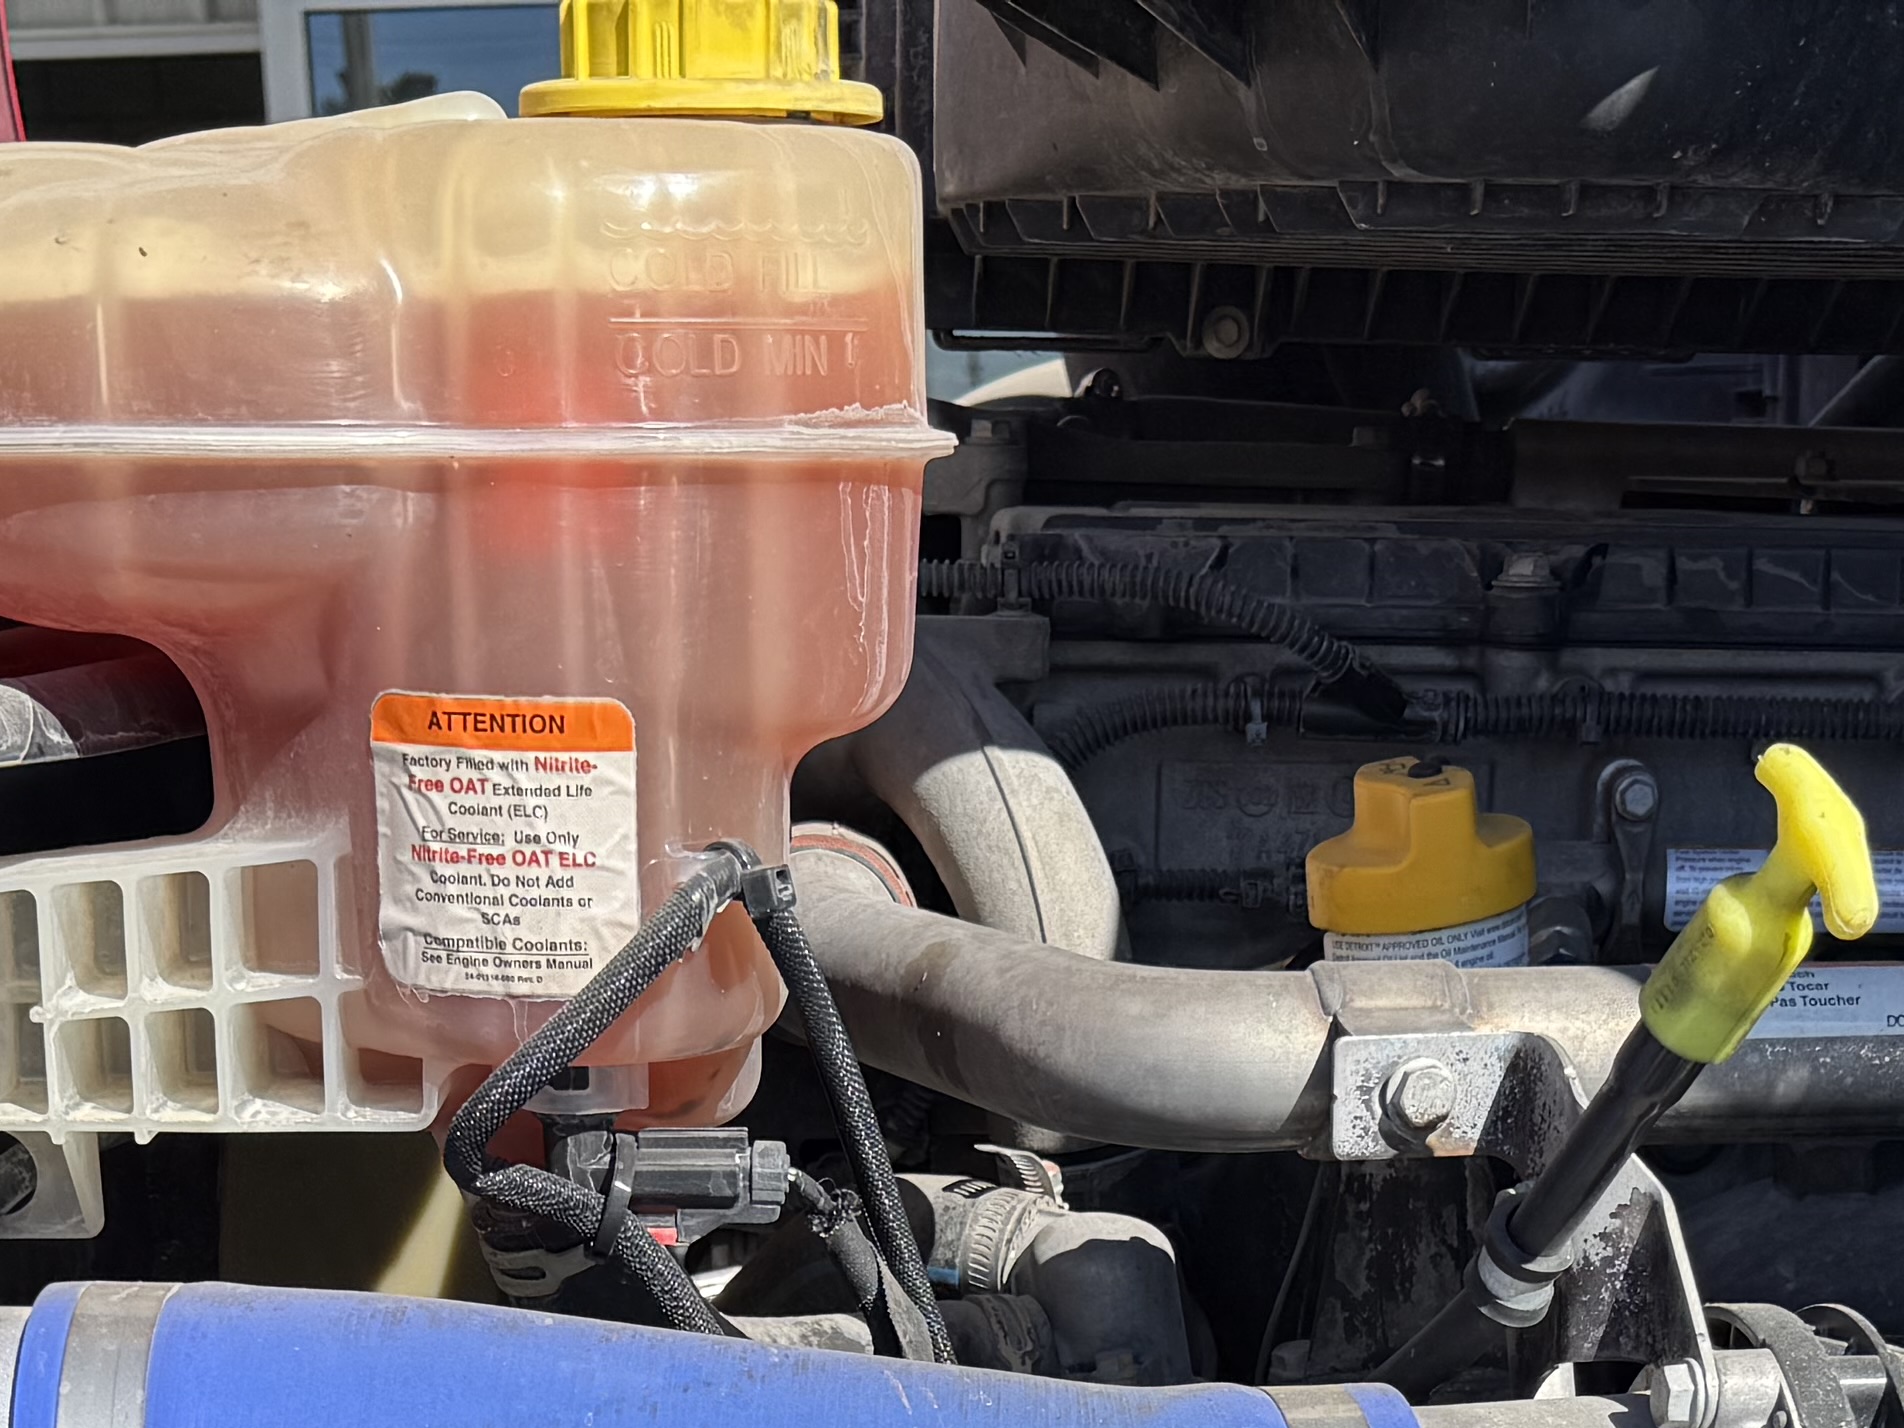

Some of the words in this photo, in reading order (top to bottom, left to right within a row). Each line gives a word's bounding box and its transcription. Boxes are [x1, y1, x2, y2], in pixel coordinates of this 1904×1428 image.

[608, 249, 733, 292] COLD
[615, 333, 739, 377] COLD
[765, 335, 828, 376] MIN
[428, 711, 565, 734] ATTENTION
[402, 753, 452, 772] Factory
[456, 756, 495, 771] Filled
[496, 758, 529, 773] with
[534, 756, 598, 774] Nitrite-
[408, 774, 444, 793] Free
[450, 777, 489, 795] OAT
[493, 784, 561, 798] Extended
[566, 785, 593, 798] Life
[448, 802, 503, 818] Coolant
[507, 804, 548, 822] (ELC)
[422, 826, 444, 842] For
[448, 828, 505, 844] Service:
[514, 831, 541, 844] Use
[547, 831, 579, 847] Only
[411, 844, 506, 866] Nitrite-Free
[512, 850, 553, 868] OAT
[558, 851, 597, 868] ELC
[430, 870, 487, 887] Coolant.
[491, 874, 511, 887] Do
[516, 875, 541, 888] Not
[546, 875, 574, 888] Add
[415, 889, 504, 906] Conventional
[509, 894, 573, 908] Coolants
[578, 898, 593, 908] or
[481, 912, 521, 926] SCAs
[424, 933, 507, 952] Compatible
[512, 938, 588, 952] Coolants:
[1382, 940, 1429, 951] APPROVED
[1430, 937, 1445, 946] OIL
[1447, 932, 1469, 944] ONLY
[421, 951, 443, 964] See
[447, 953, 489, 968] Engine
[493, 957, 542, 969] Owners
[546, 958, 593, 970] Manual
[1790, 981, 1829, 992] Tocar
[1770, 995, 1797, 1007] Pas
[1801, 995, 1861, 1007] Toucher
